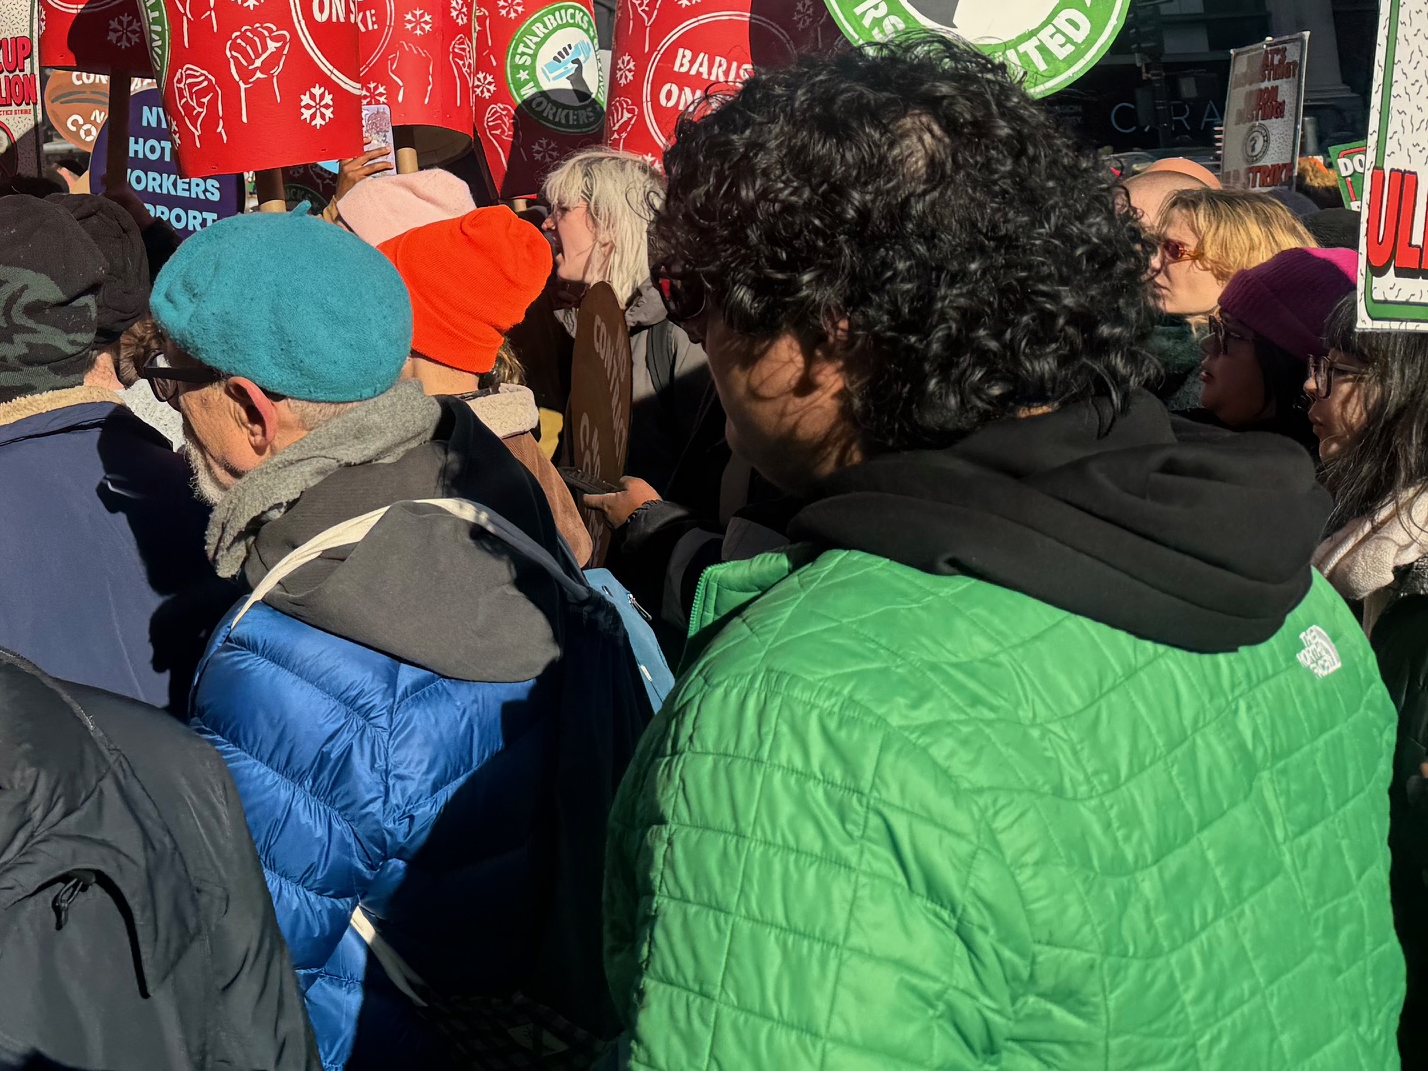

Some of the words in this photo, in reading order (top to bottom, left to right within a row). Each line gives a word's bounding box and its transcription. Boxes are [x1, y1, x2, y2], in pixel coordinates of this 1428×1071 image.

[514, 8, 590, 66] STARBUCKS
[520, 81, 596, 125] WORKERS
[1110, 100, 1222, 134] CRA
[129, 136, 172, 162] HOT
[127, 169, 221, 202] ORKERS
[1365, 167, 1428, 279] UL
